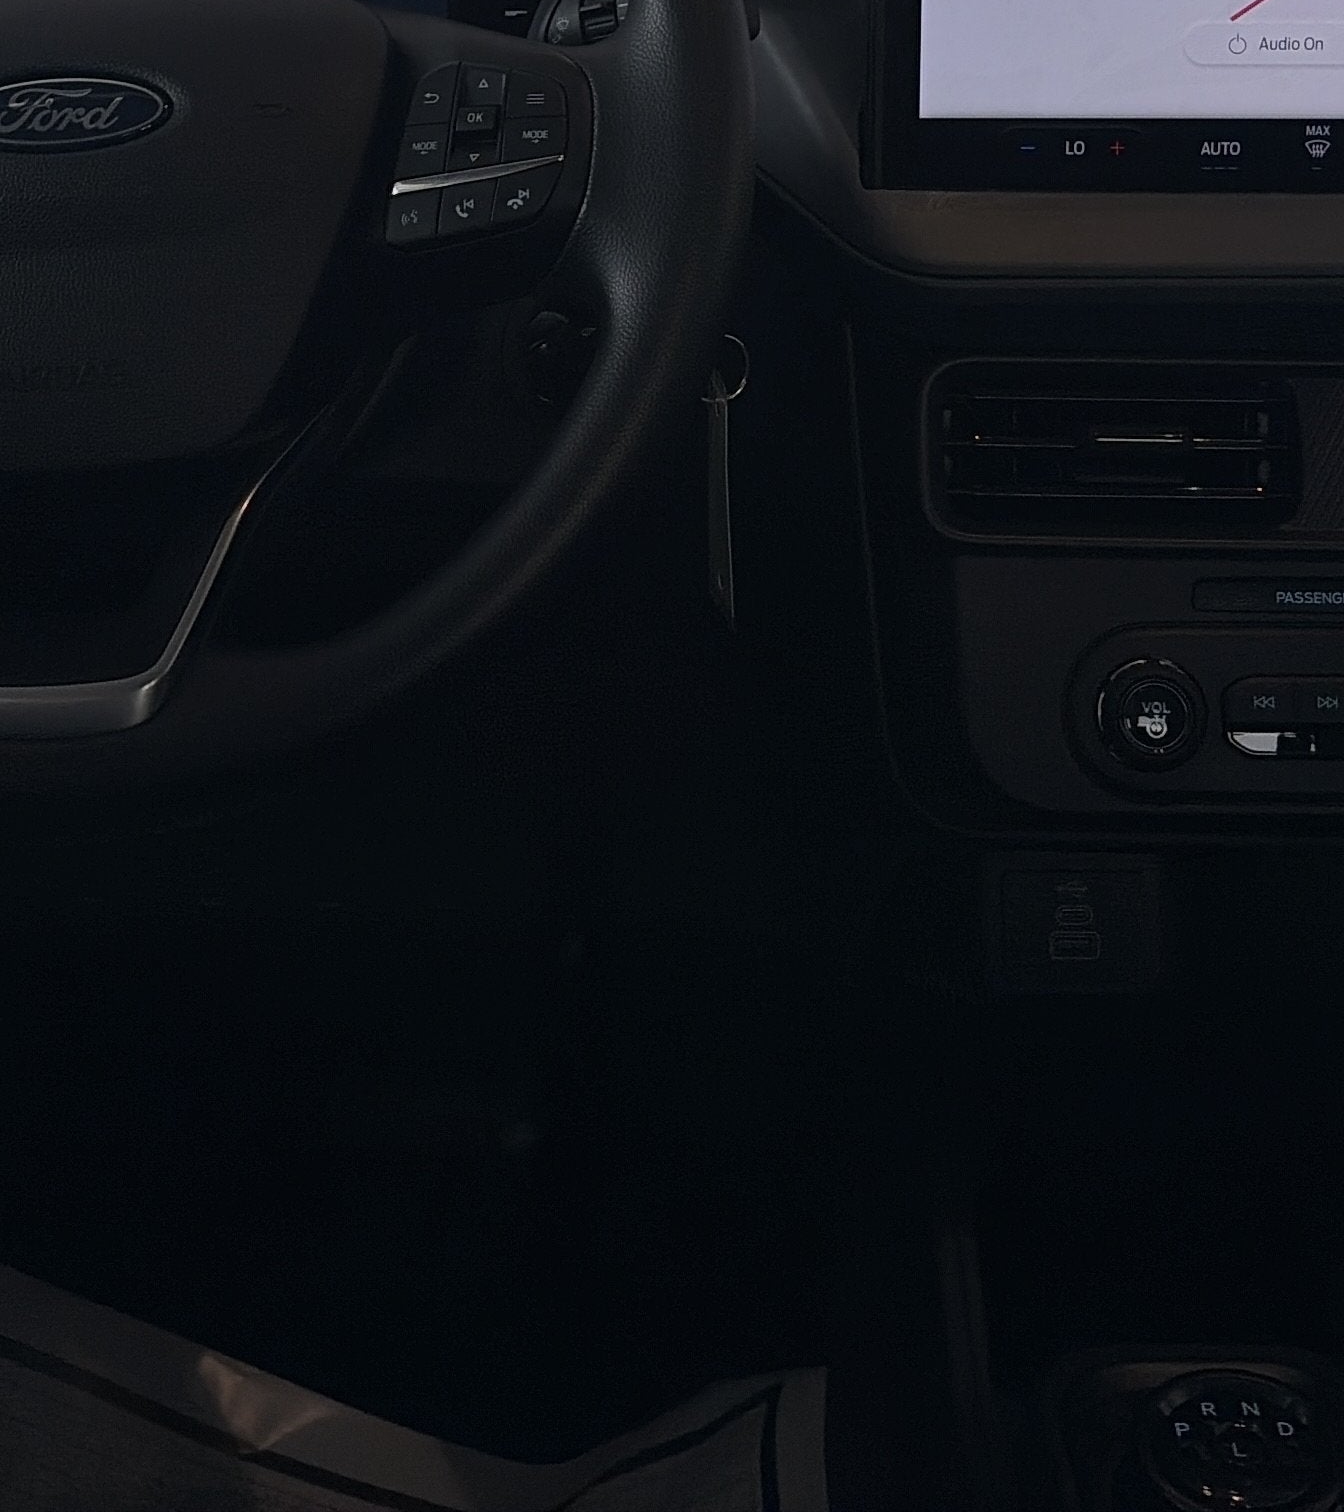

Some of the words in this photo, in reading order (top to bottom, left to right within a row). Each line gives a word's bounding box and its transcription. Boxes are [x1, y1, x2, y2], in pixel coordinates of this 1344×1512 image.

[1259, 36, 1300, 51] Audio
[1304, 36, 1324, 51] On
[466, 113, 484, 123] OK
[522, 129, 549, 139] MODE
[1306, 125, 1331, 137] MAX
[412, 141, 439, 151] MODE
[1065, 140, 1085, 155] LO
[1200, 141, 1241, 156] AUTO
[1142, 701, 1171, 714] VOL
[1200, 1402, 1217, 1416] R
[1241, 1402, 1261, 1416] N
[1174, 1422, 1190, 1437] P
[1277, 1422, 1294, 1436] D
